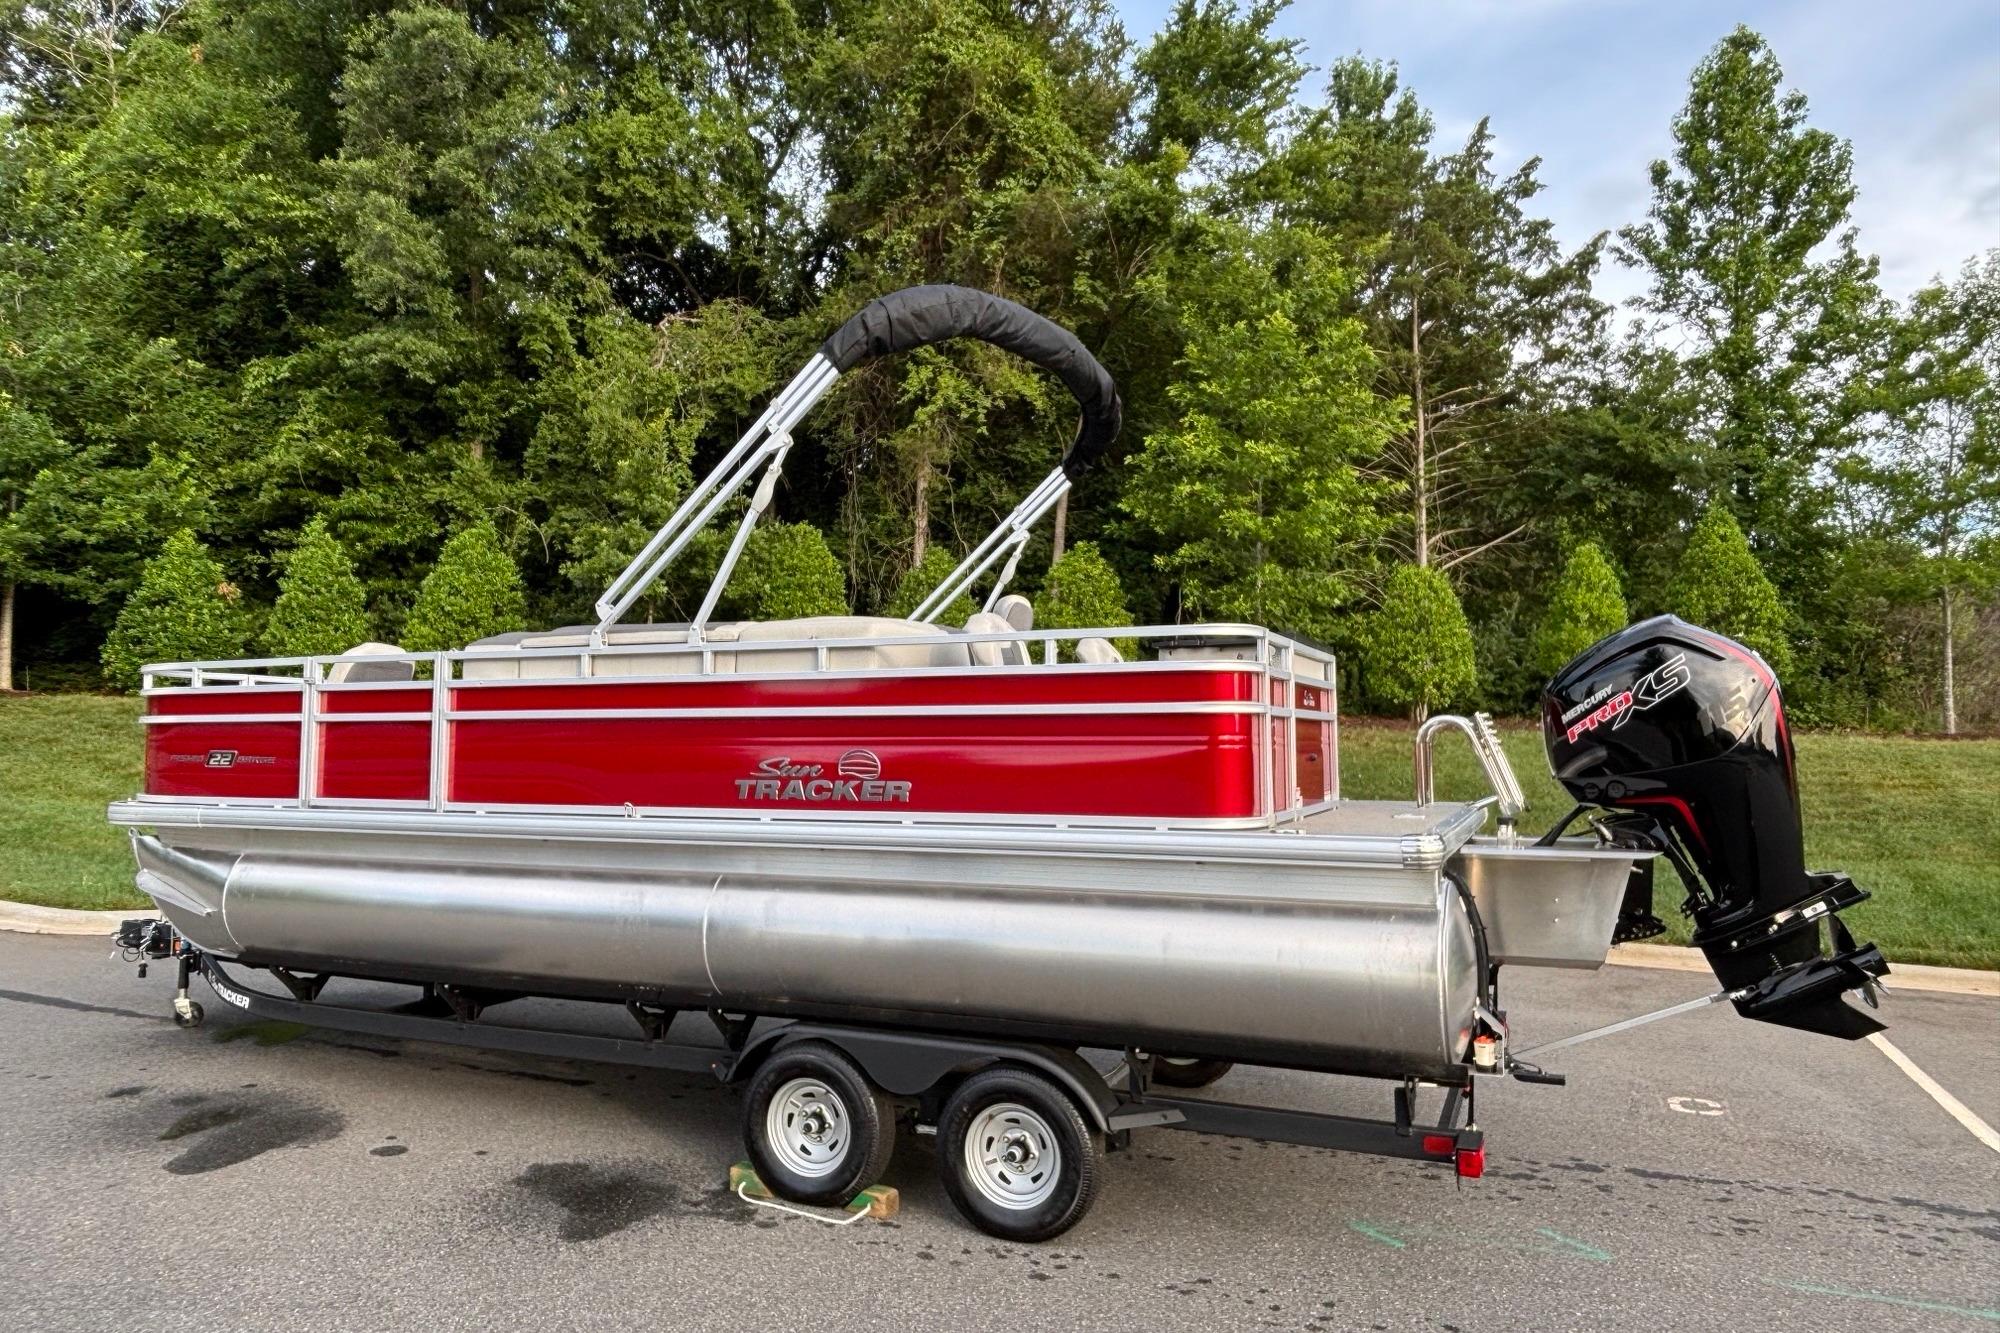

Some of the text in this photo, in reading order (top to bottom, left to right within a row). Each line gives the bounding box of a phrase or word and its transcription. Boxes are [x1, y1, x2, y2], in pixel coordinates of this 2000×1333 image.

[1562, 684, 1613, 724] MERCURY
[1567, 652, 1691, 744] PRO XS
[209, 753, 232, 766] 22
[750, 757, 824, 778] Sun
[735, 779, 912, 803] TRACKER
